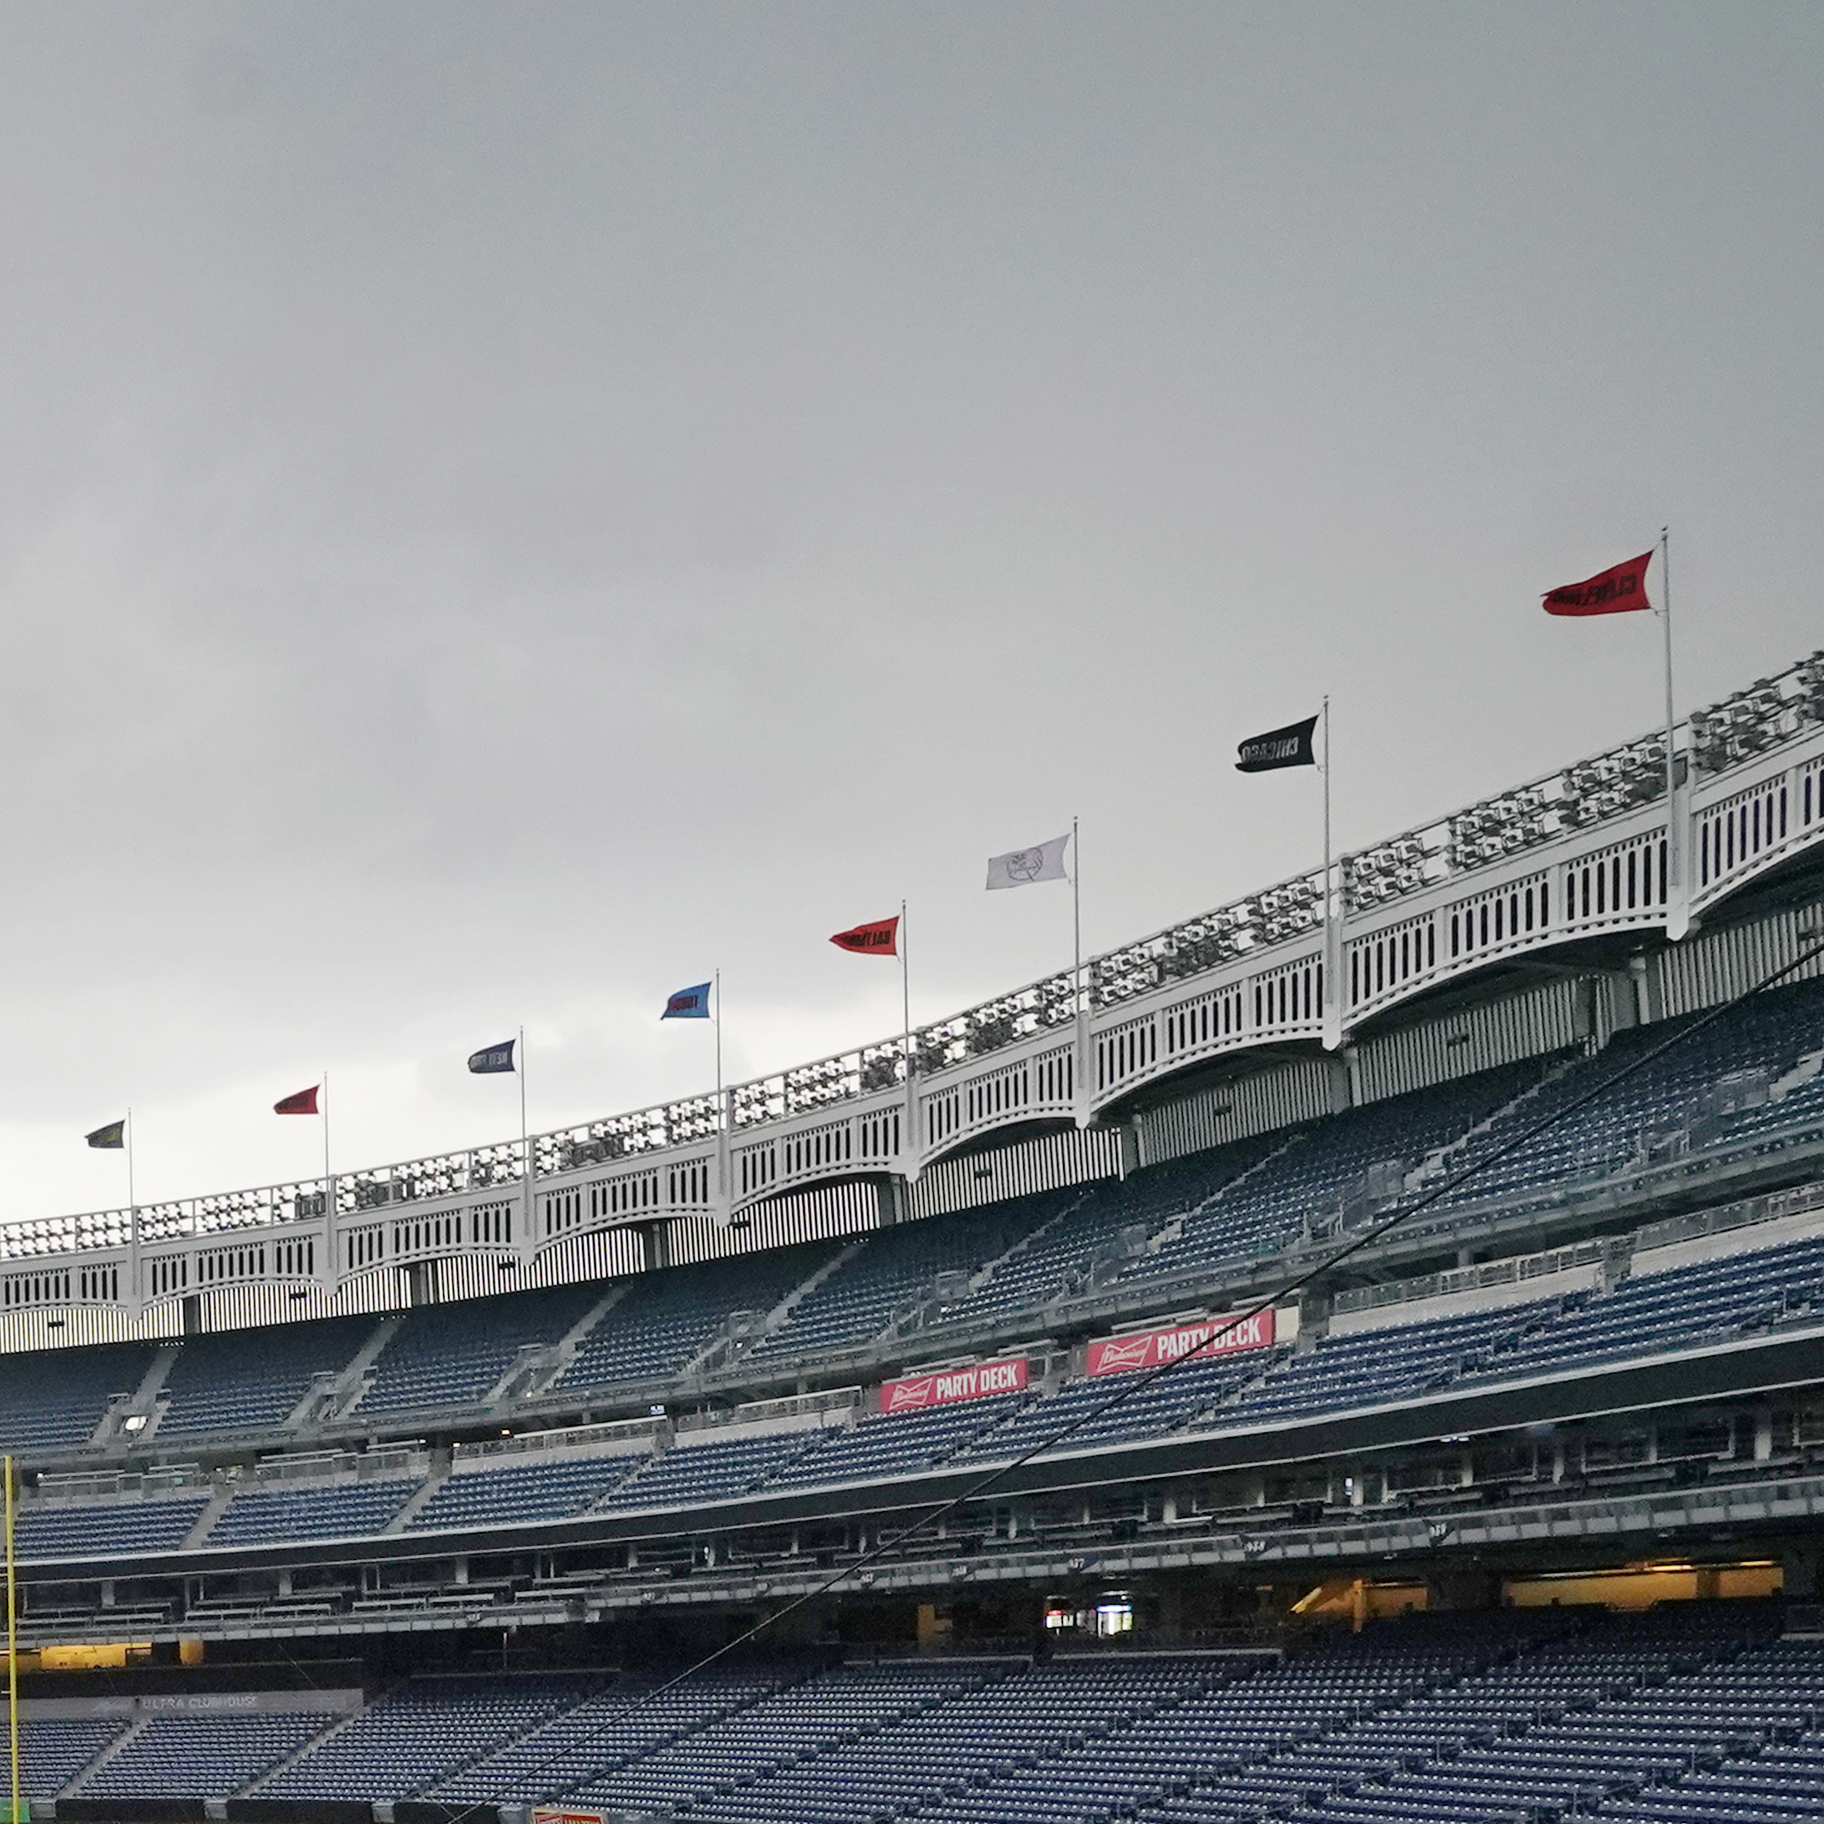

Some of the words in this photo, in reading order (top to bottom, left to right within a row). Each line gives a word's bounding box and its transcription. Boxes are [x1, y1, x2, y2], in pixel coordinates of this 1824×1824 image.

[1157, 1327, 1210, 1360] PARTY
[1214, 1316, 1262, 1351] DECK
[936, 1370, 978, 1400] PARTY
[980, 1363, 1018, 1391] DECK
